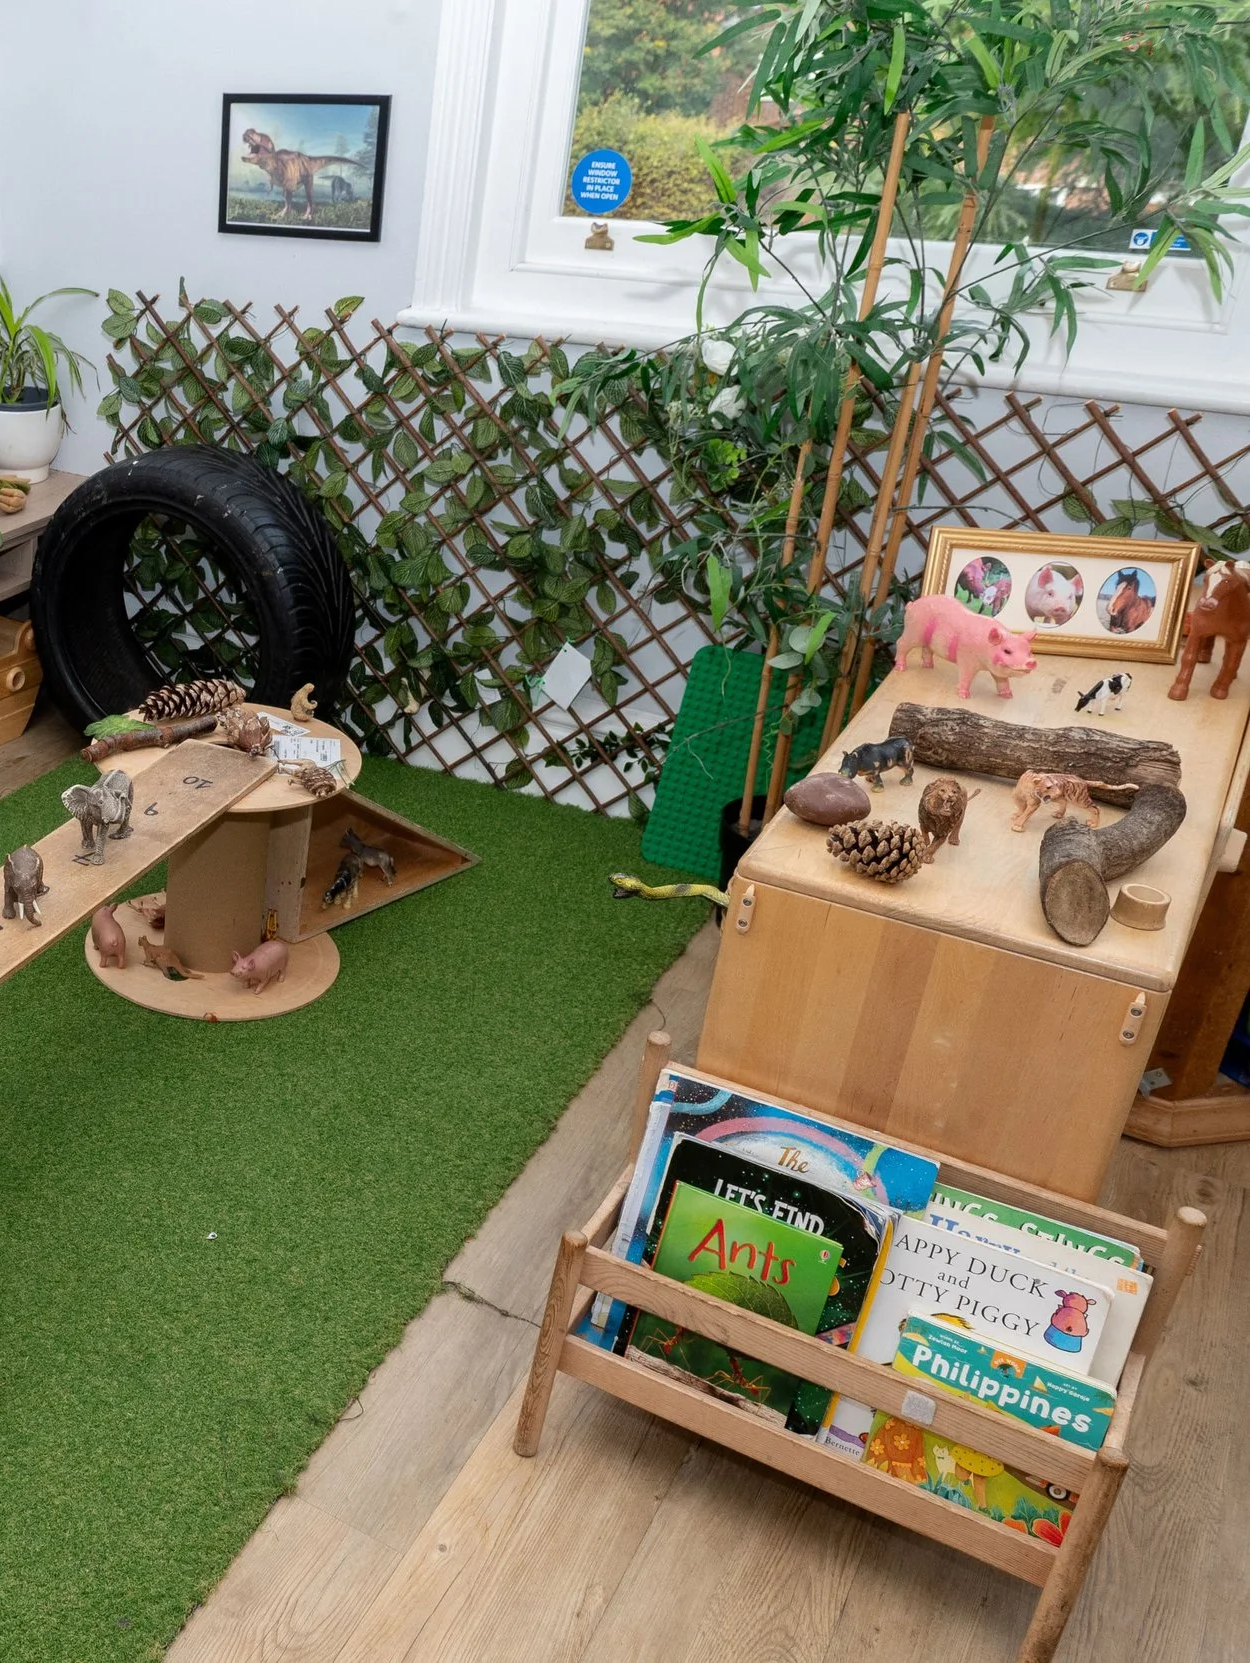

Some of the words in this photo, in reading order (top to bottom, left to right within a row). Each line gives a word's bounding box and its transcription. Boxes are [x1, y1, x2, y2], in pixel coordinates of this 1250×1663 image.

[588, 169, 618, 177] WINDOW
[591, 161, 616, 169] ENSURE
[582, 176, 621, 185] RESTRICTOR
[777, 1146, 810, 1174] The
[713, 1178, 767, 1214] LET'S
[772, 1200, 825, 1237] FIND
[688, 1218, 797, 1286] Ants
[894, 1233, 961, 1267] APPY
[966, 1256, 1050, 1299] DUCK
[937, 1269, 970, 1290] and
[879, 1268, 949, 1304] OTTY
[955, 1294, 1040, 1337] PIGGY
[912, 1345, 1092, 1433] Philippines
[824, 1436, 860, 1456] Bernette
